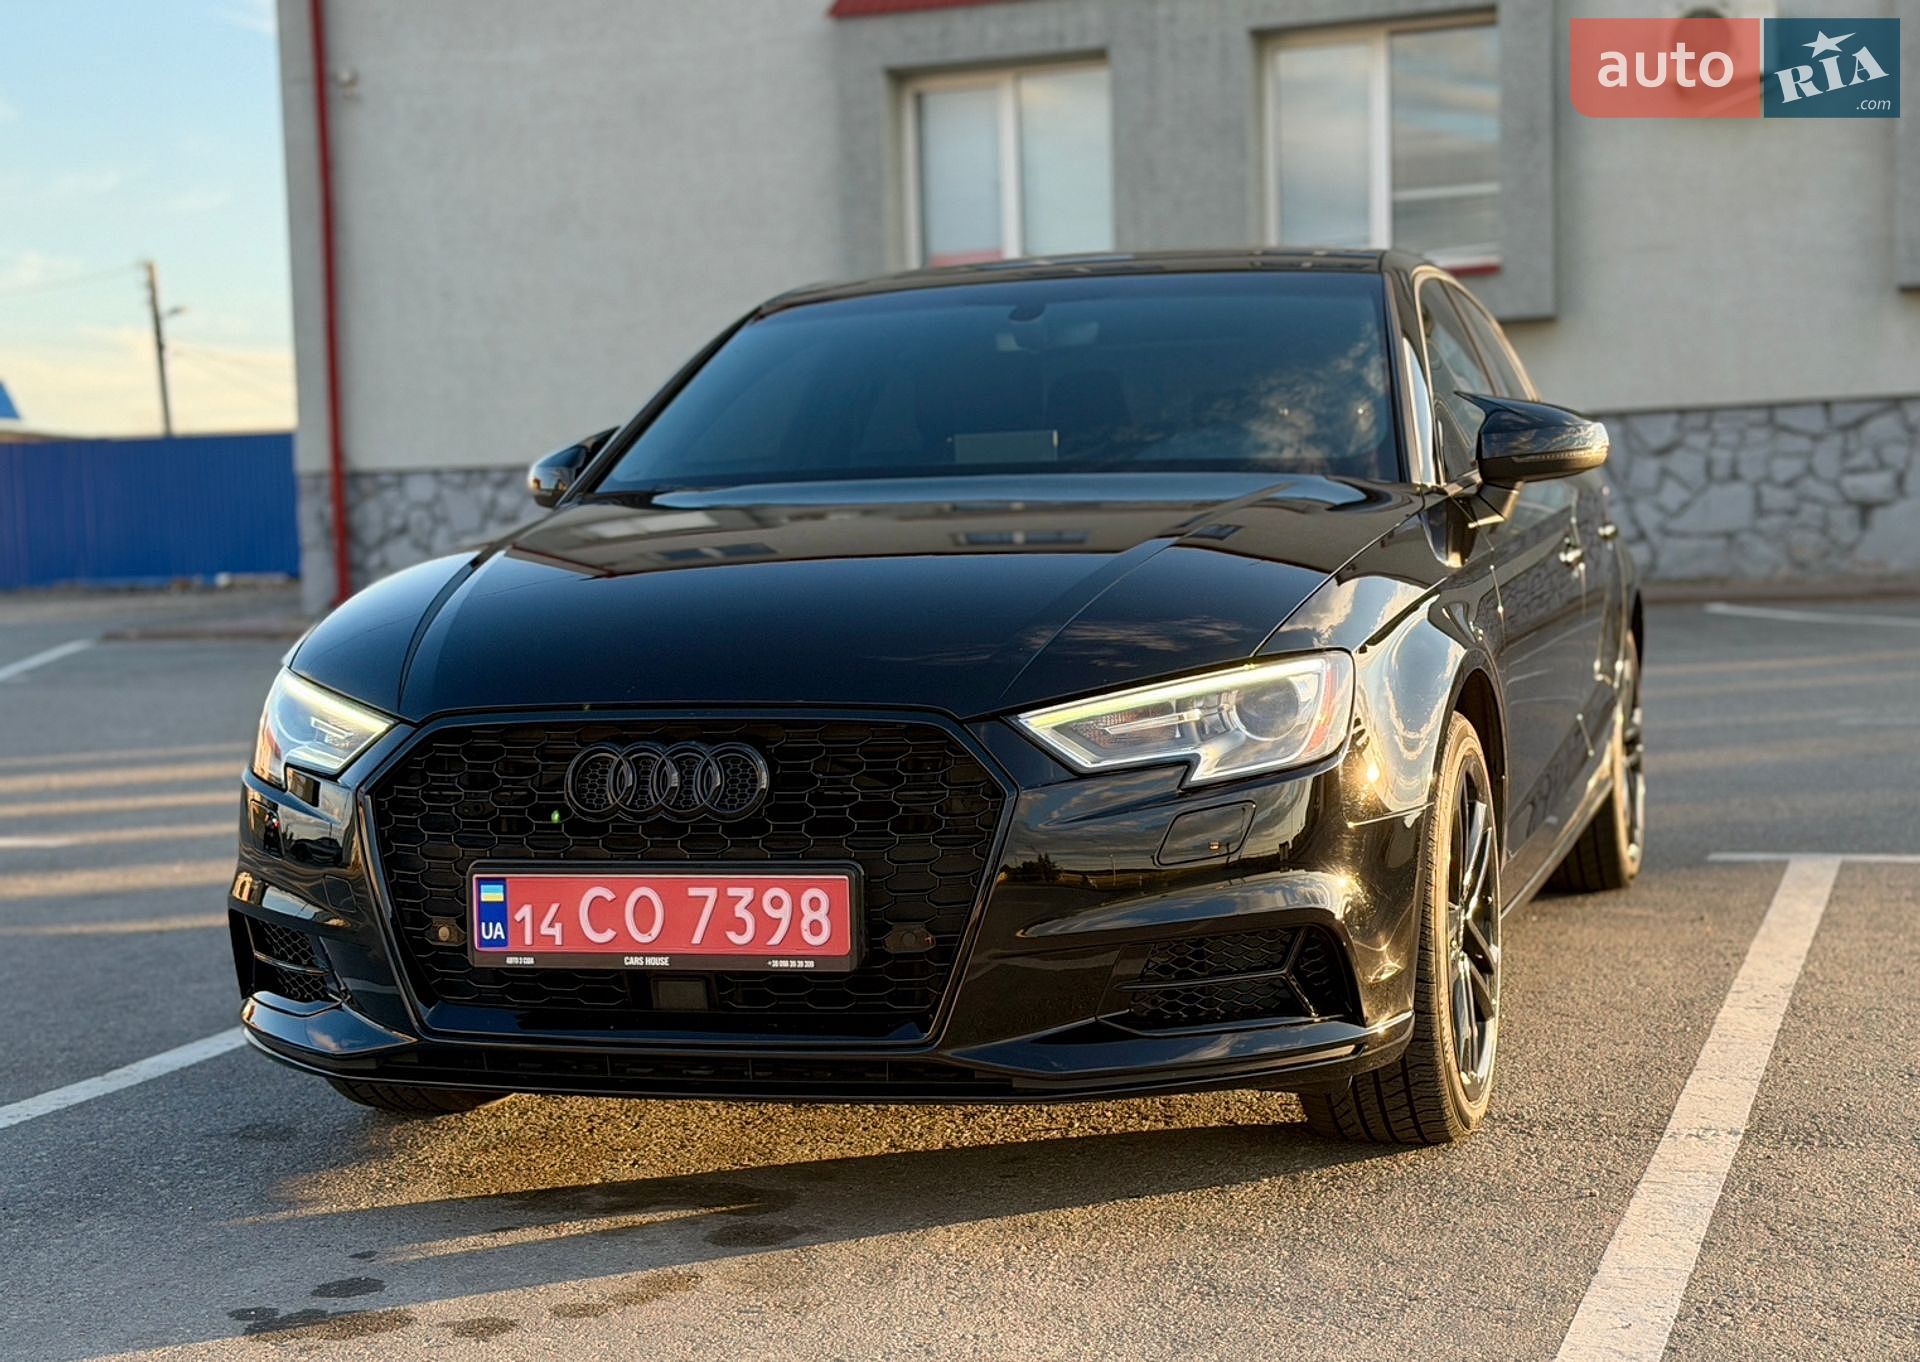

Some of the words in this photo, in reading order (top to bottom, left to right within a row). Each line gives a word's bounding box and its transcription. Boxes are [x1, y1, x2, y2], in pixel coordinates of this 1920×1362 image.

[481, 921, 505, 939] UA
[514, 902, 563, 946] 14
[578, 886, 664, 944] CO
[687, 887, 832, 946] 7398
[624, 956, 644, 966] CARS
[645, 956, 670, 966] HOUSE
